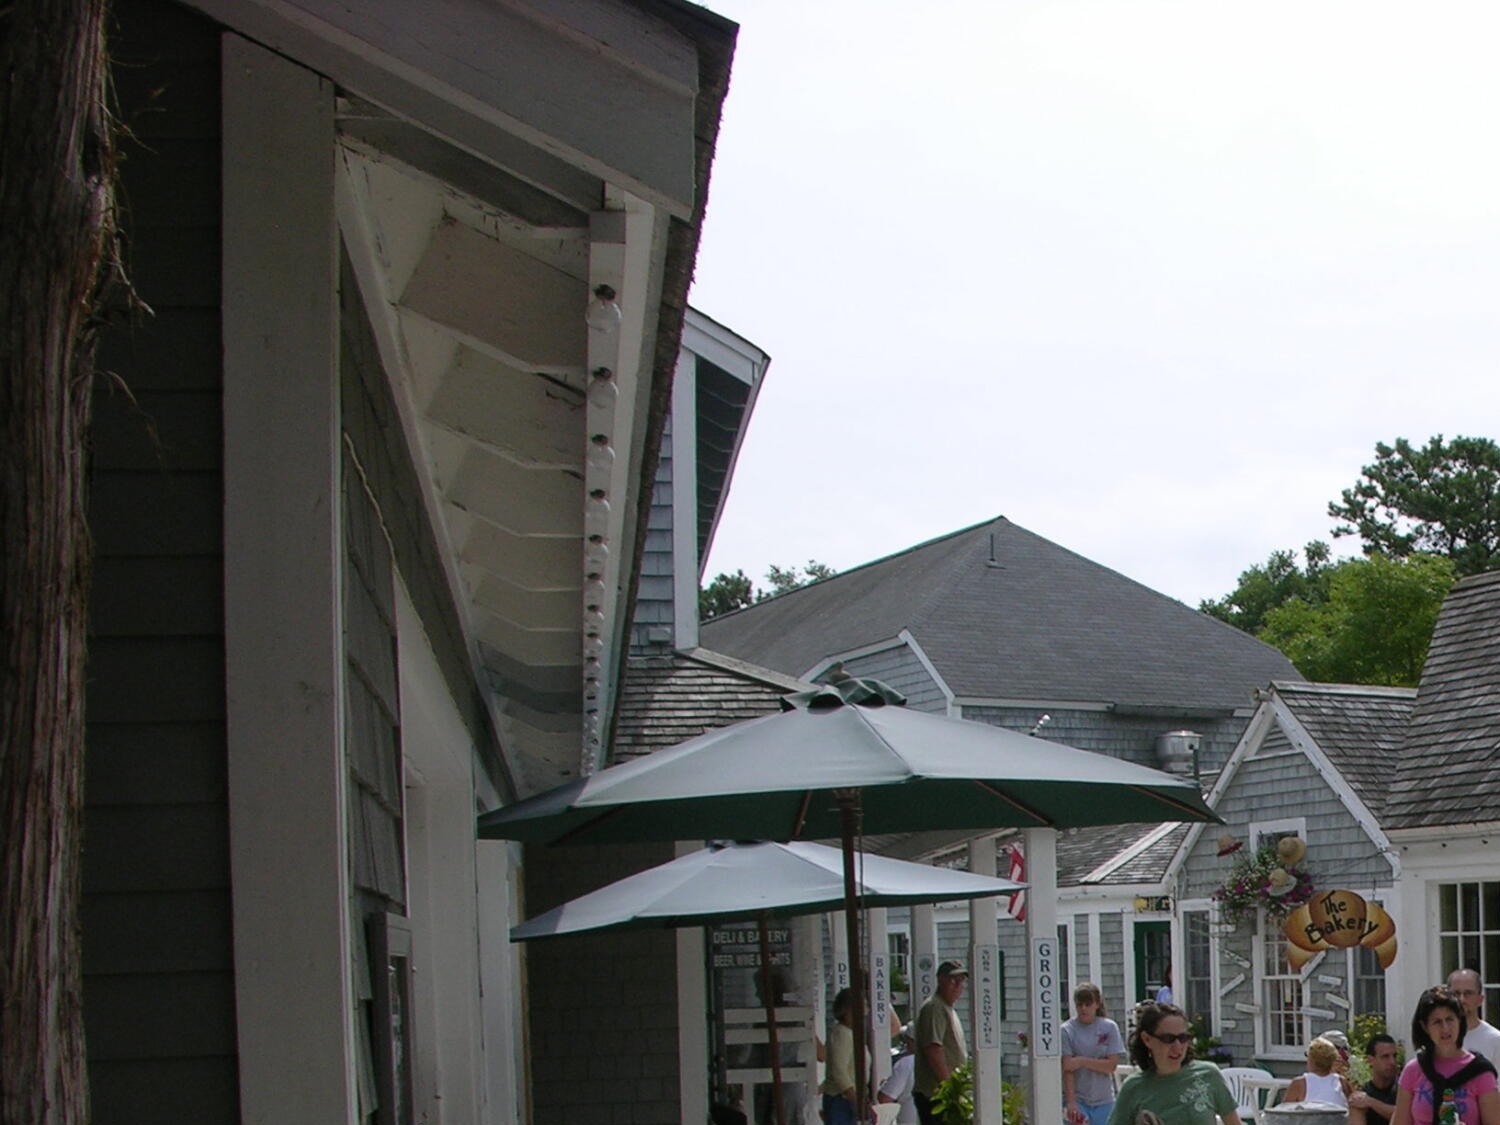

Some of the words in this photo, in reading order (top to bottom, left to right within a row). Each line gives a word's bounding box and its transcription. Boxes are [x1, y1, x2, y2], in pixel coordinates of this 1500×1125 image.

[1320, 889, 1347, 914] The
[713, 931, 736, 944] DELI
[737, 931, 745, 944] &
[747, 930, 789, 944] BAERY
[1304, 914, 1380, 944] Bakery
[875, 956, 885, 1024] BAKERY
[1038, 943, 1052, 1051] GROCERY
